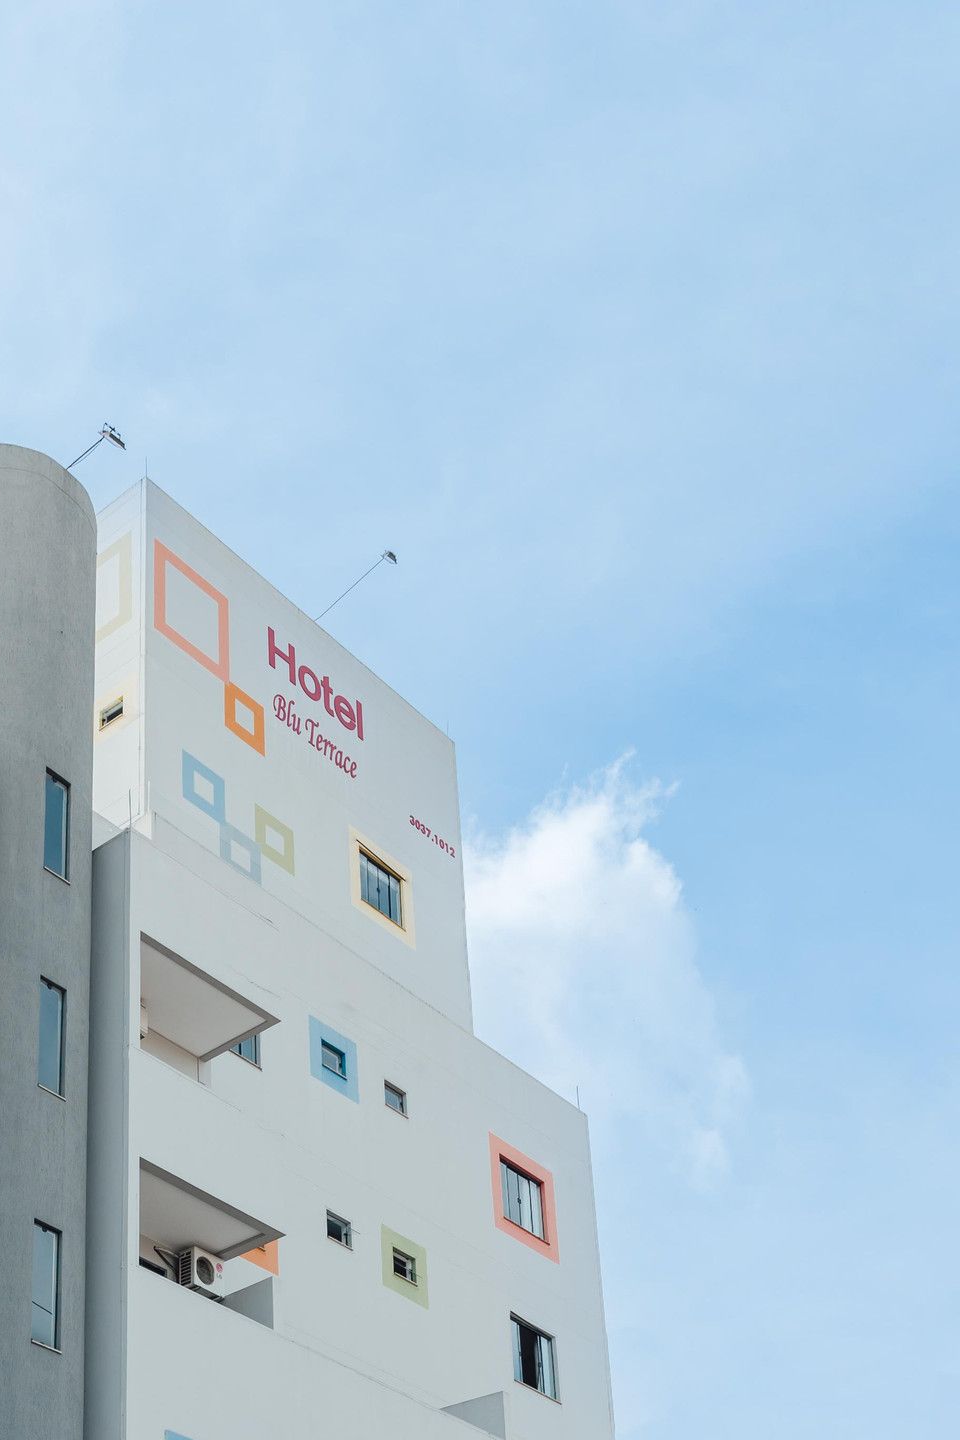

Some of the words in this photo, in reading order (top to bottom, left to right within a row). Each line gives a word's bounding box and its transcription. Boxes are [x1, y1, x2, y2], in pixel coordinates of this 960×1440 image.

[267, 626, 364, 742] Hotel
[273, 694, 302, 736] Blu
[305, 718, 358, 779] Terrace
[409, 815, 456, 858] 3037.1012
